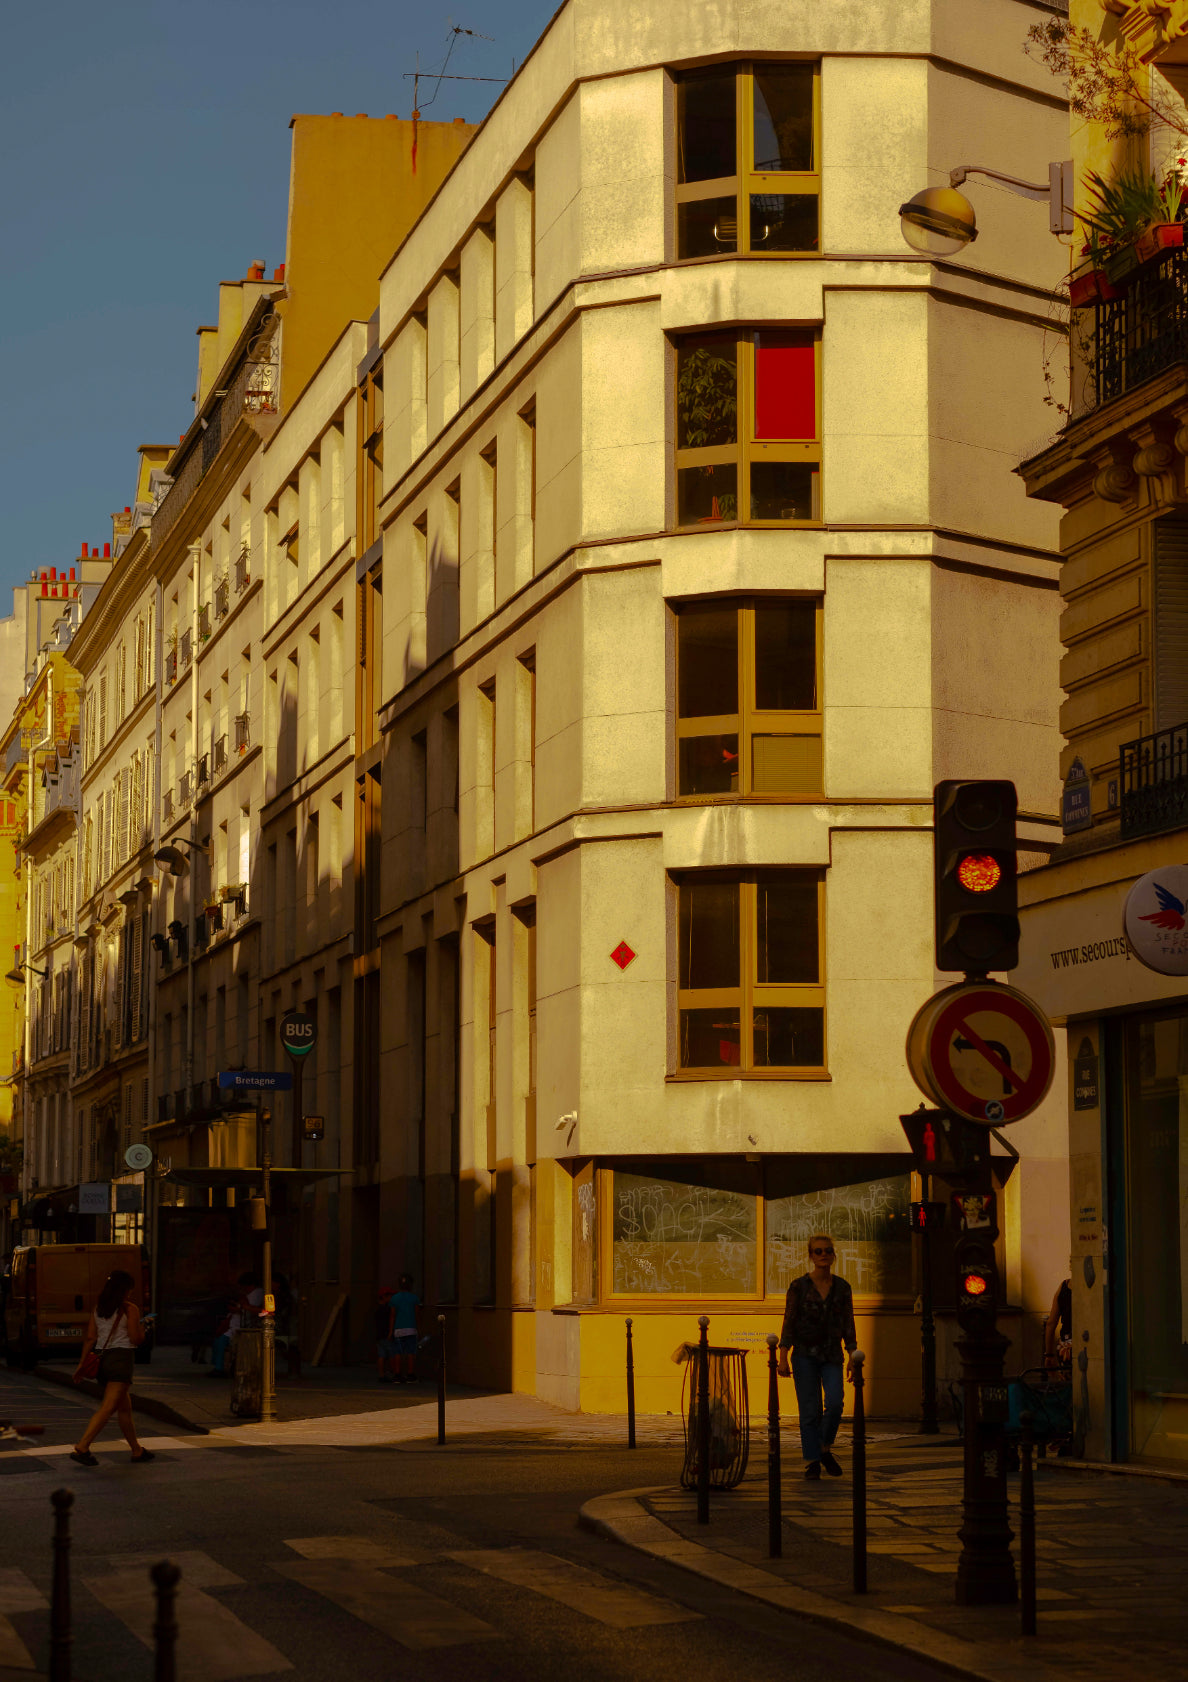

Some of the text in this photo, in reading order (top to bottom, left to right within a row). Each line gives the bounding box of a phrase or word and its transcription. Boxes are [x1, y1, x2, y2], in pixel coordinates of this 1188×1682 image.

[1071, 793, 1082, 805] RUE
[1109, 784, 1116, 804] 6
[286, 1023, 313, 1037] BUS
[235, 1076, 276, 1087] Bretagne
